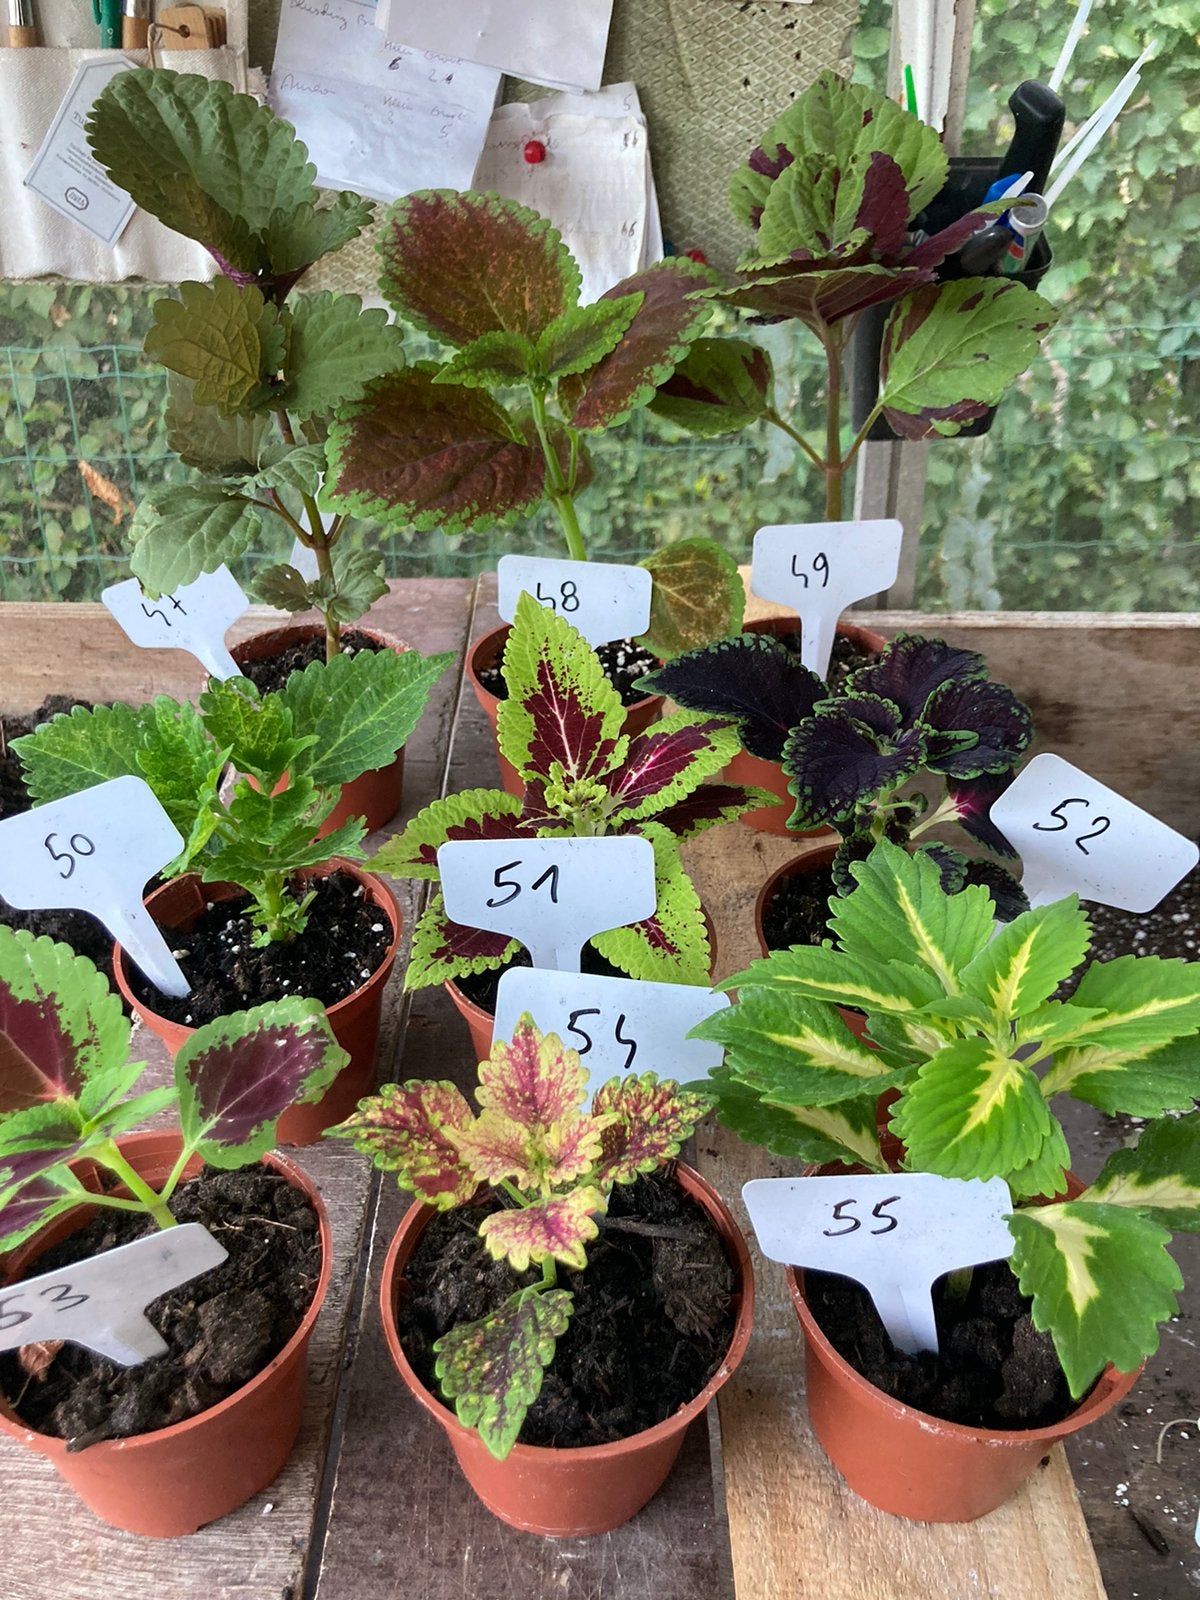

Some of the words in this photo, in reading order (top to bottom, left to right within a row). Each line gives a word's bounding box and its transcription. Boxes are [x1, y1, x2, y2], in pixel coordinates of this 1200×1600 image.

[791, 552, 830, 588] 49
[536, 580, 580, 612] 48
[1032, 798, 1111, 855] 52
[44, 832, 96, 879] 50
[486, 860, 559, 908] 51
[567, 1008, 637, 1069] 54
[823, 1195, 902, 1237] 55
[0, 1283, 90, 1331] 53
